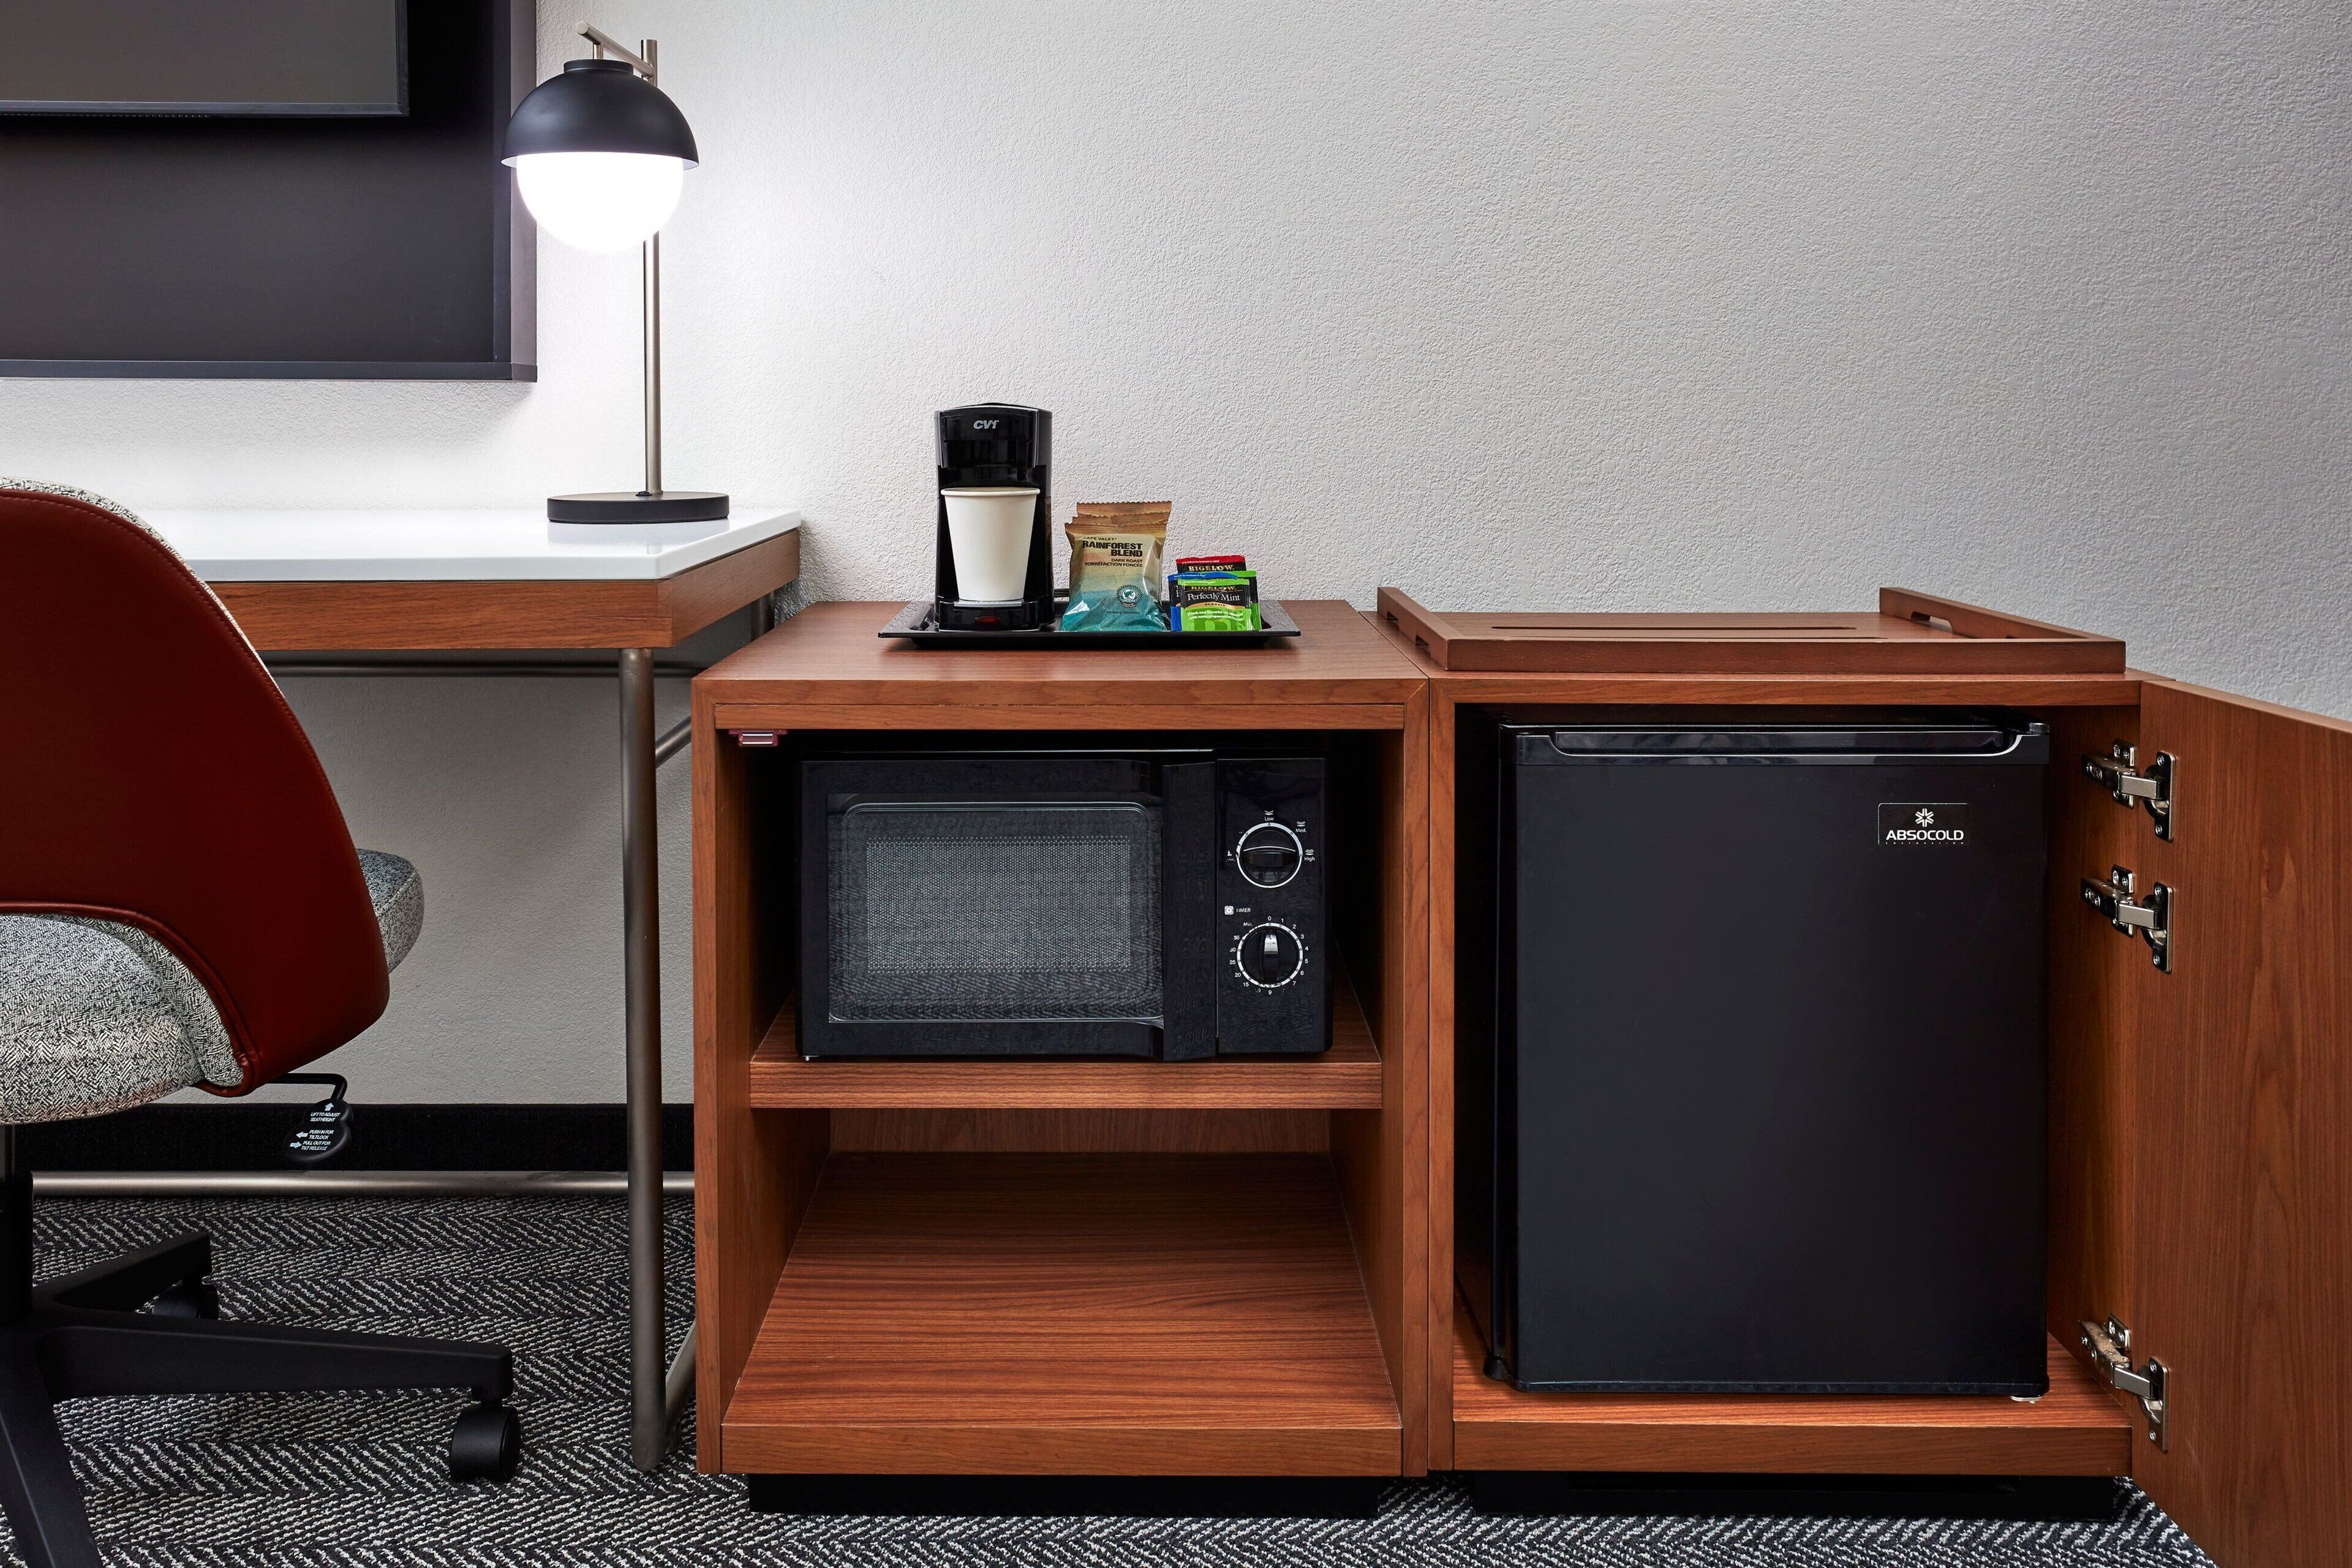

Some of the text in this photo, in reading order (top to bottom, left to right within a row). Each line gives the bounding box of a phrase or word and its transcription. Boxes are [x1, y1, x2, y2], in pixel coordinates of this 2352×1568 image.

[1082, 540, 1143, 550] RAINFOREST
[1187, 592, 1219, 601] Perfectly
[1886, 830, 1964, 840] ABSOCOLD
